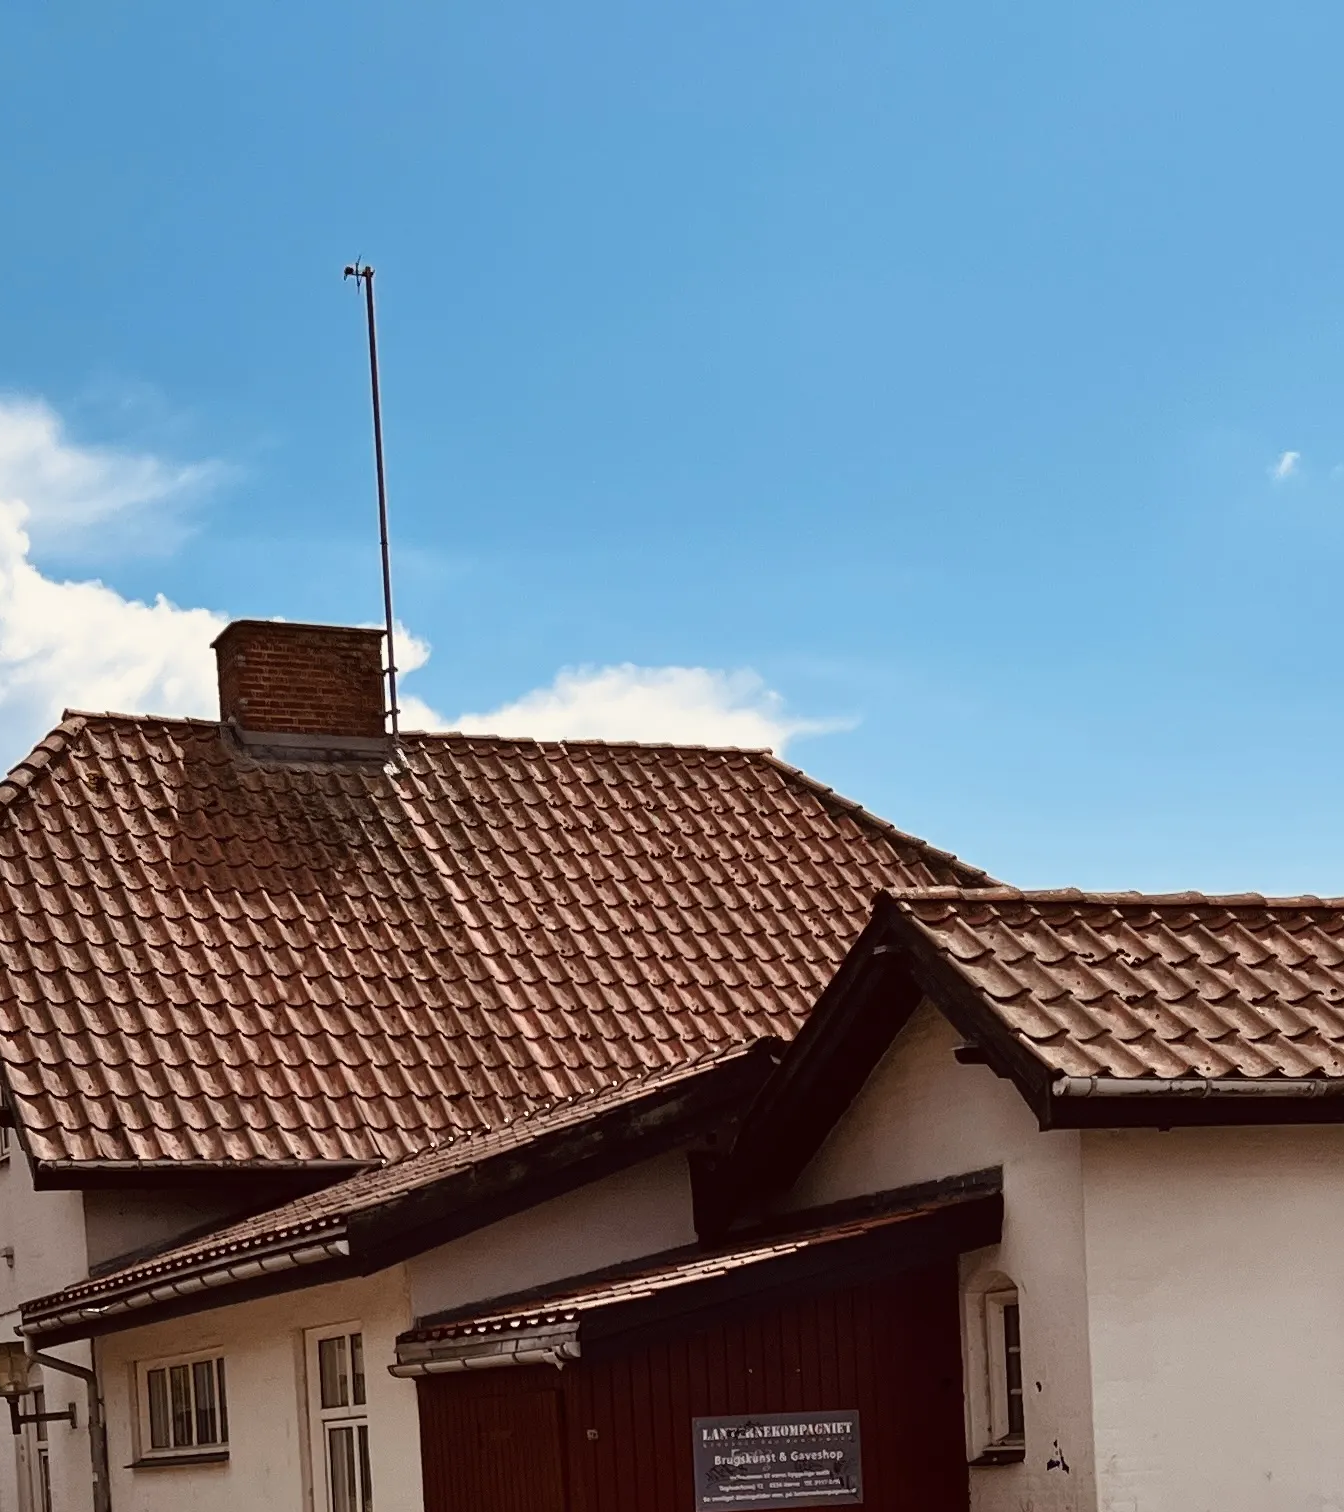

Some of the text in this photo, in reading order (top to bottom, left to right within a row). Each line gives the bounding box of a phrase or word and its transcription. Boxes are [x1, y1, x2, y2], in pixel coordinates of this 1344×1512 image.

[714, 1449, 844, 1466] Brugskunst & Gaveshop
